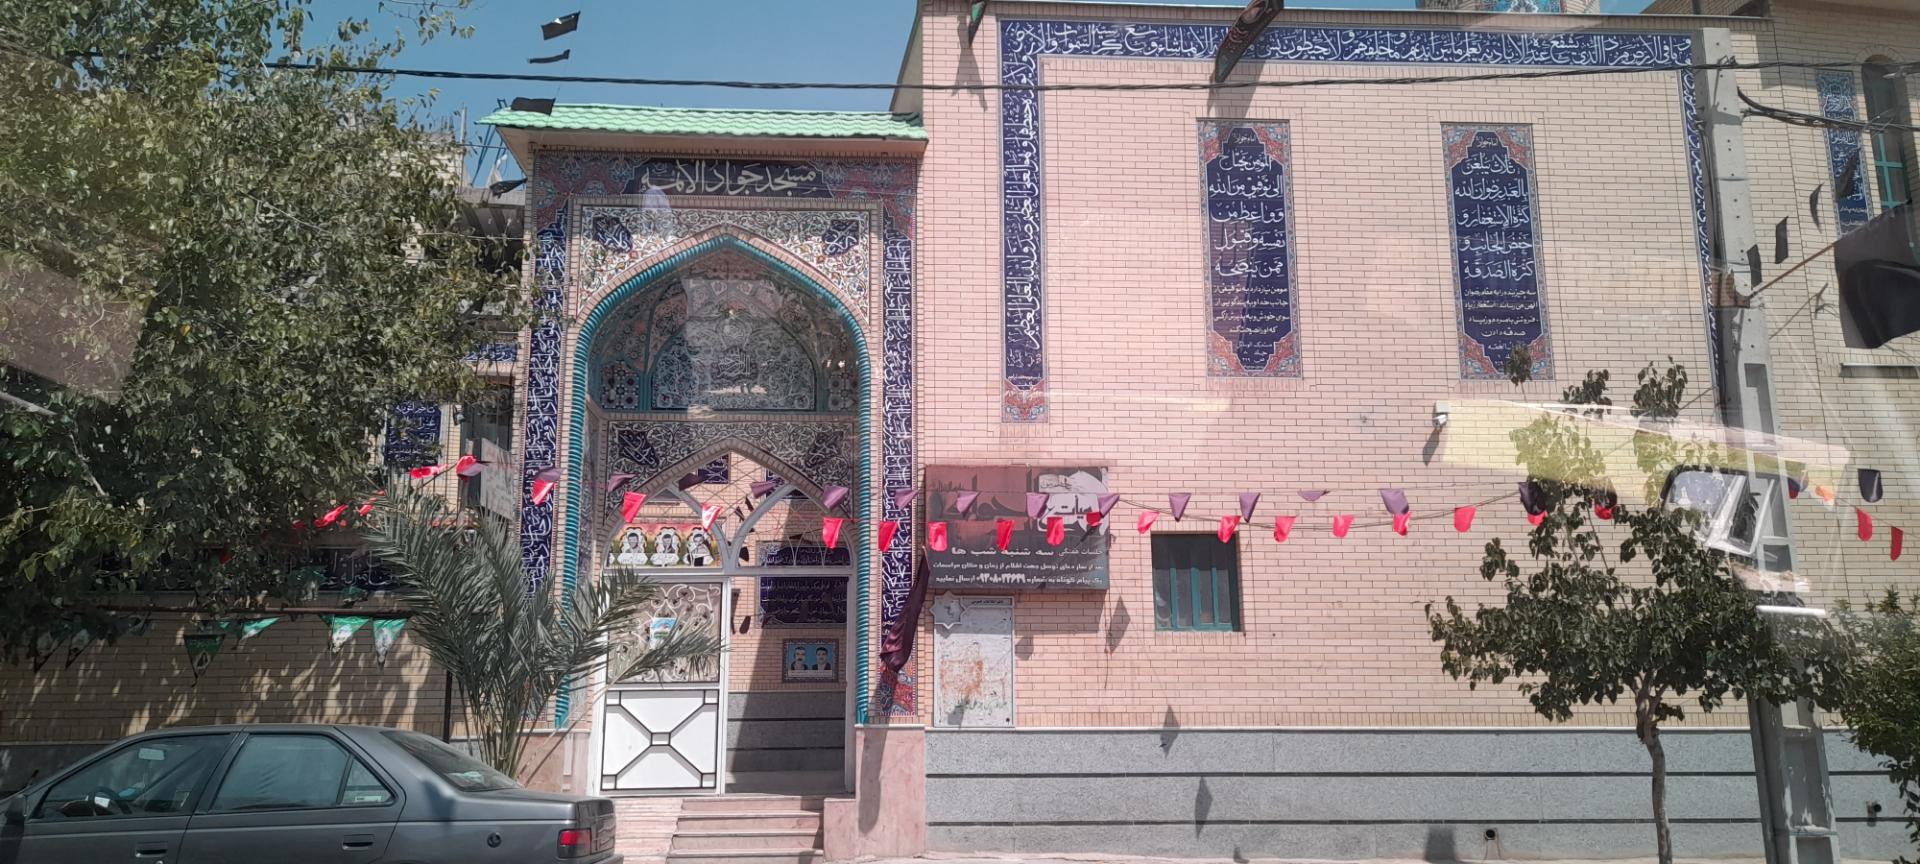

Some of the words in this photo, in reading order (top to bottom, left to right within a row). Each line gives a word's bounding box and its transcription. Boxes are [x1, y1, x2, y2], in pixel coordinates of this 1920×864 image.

[705, 160, 764, 196] جواد
[755, 165, 817, 197] مسجد
[951, 546, 967, 555] ها
[970, 547, 997, 556] شب
[1001, 548, 1032, 558] شنبه
[1027, 576, 1046, 584] شماره
[1056, 576, 1075, 584] کوتاه
